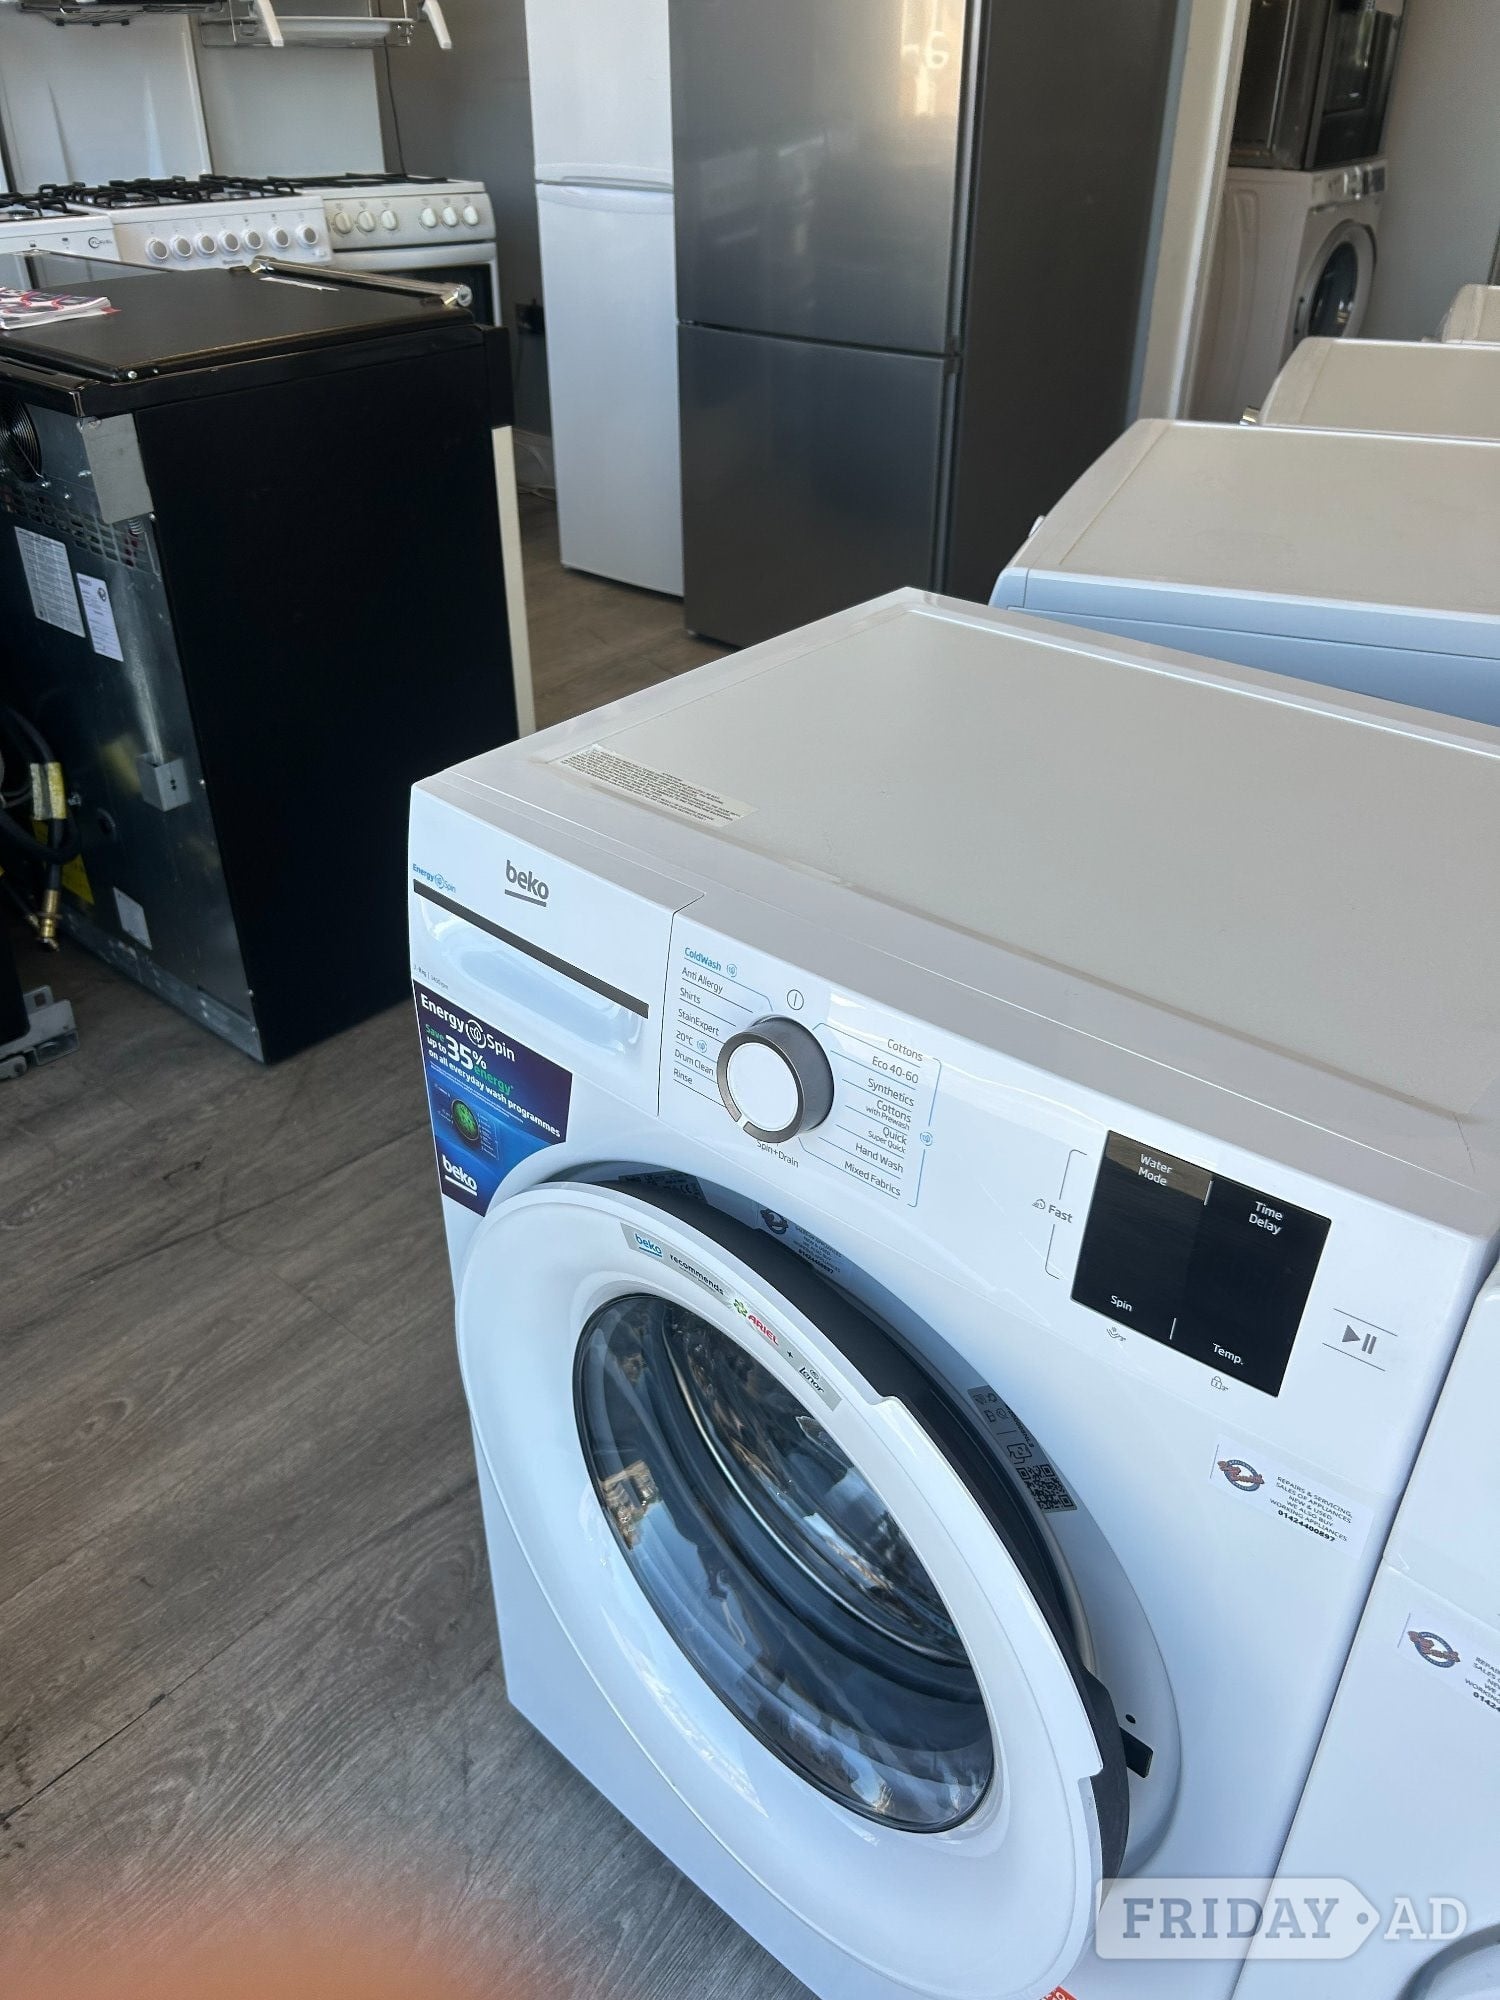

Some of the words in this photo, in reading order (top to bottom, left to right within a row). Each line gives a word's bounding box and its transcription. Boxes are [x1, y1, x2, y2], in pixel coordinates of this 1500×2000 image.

[412, 863, 434, 882] Energy
[505, 860, 549, 900] beko
[685, 947, 722, 971] ColdWash
[682, 967, 697, 981] Anti
[698, 974, 723, 994] Allergy
[680, 987, 701, 1004] Shirts
[421, 993, 464, 1033] Energy
[486, 1034, 515, 1062] Spin
[425, 1024, 445, 1042] Save
[678, 1008, 720, 1036] StainExpert
[427, 1036, 437, 1049] up
[438, 1042, 447, 1054] to
[446, 1034, 487, 1070] 35%
[887, 1038, 923, 1061] Cottons
[674, 1049, 694, 1065] Drum
[695, 1059, 714, 1075] Clean
[872, 1056, 888, 1071] Eco
[889, 1064, 919, 1084] 40-60
[674, 1068, 693, 1085] Rinse
[429, 1050, 438, 1061] on
[440, 1056, 448, 1067] all
[449, 1061, 484, 1091] everyday
[486, 1085, 507, 1104] wash
[507, 1100, 561, 1138] programmes
[868, 1078, 914, 1107] Synthetics
[866, 1106, 881, 1118] with
[881, 1112, 910, 1131] Prewash
[877, 1099, 911, 1122] Cottons
[868, 1130, 886, 1145] Super
[888, 1139, 906, 1153] Quick
[882, 1126, 907, 1145] Quick
[855, 1143, 878, 1160] Hand
[879, 1155, 904, 1173] Wash
[1140, 1153, 1173, 1175] Water
[442, 1155, 477, 1190] beko
[844, 1161, 869, 1181] Mixed
[870, 1174, 901, 1196] Fabrics
[1138, 1166, 1168, 1187] Mode
[1048, 1204, 1073, 1224] Fast
[1255, 1201, 1283, 1221] Time
[1249, 1213, 1282, 1236] Delay
[635, 1233, 662, 1254] beko
[669, 1254, 724, 1295] recommends
[748, 1314, 779, 1346] ARIEL
[799, 1366, 825, 1393] Lenor
[1110, 1295, 1132, 1312] Spin
[1212, 1342, 1244, 1365] Temp.
[1276, 1482, 1297, 1496] SALES
[1278, 1476, 1305, 1494] REPAIRS
[1289, 1495, 1306, 1507] NEW
[1269, 1498, 1303, 1519] WORKING
[1305, 1517, 1348, 1542] APPLIANCES
[1287, 1500, 1298, 1509] WE
[1299, 1508, 1317, 1519] ALSO
[1318, 1517, 1334, 1527] BUY
